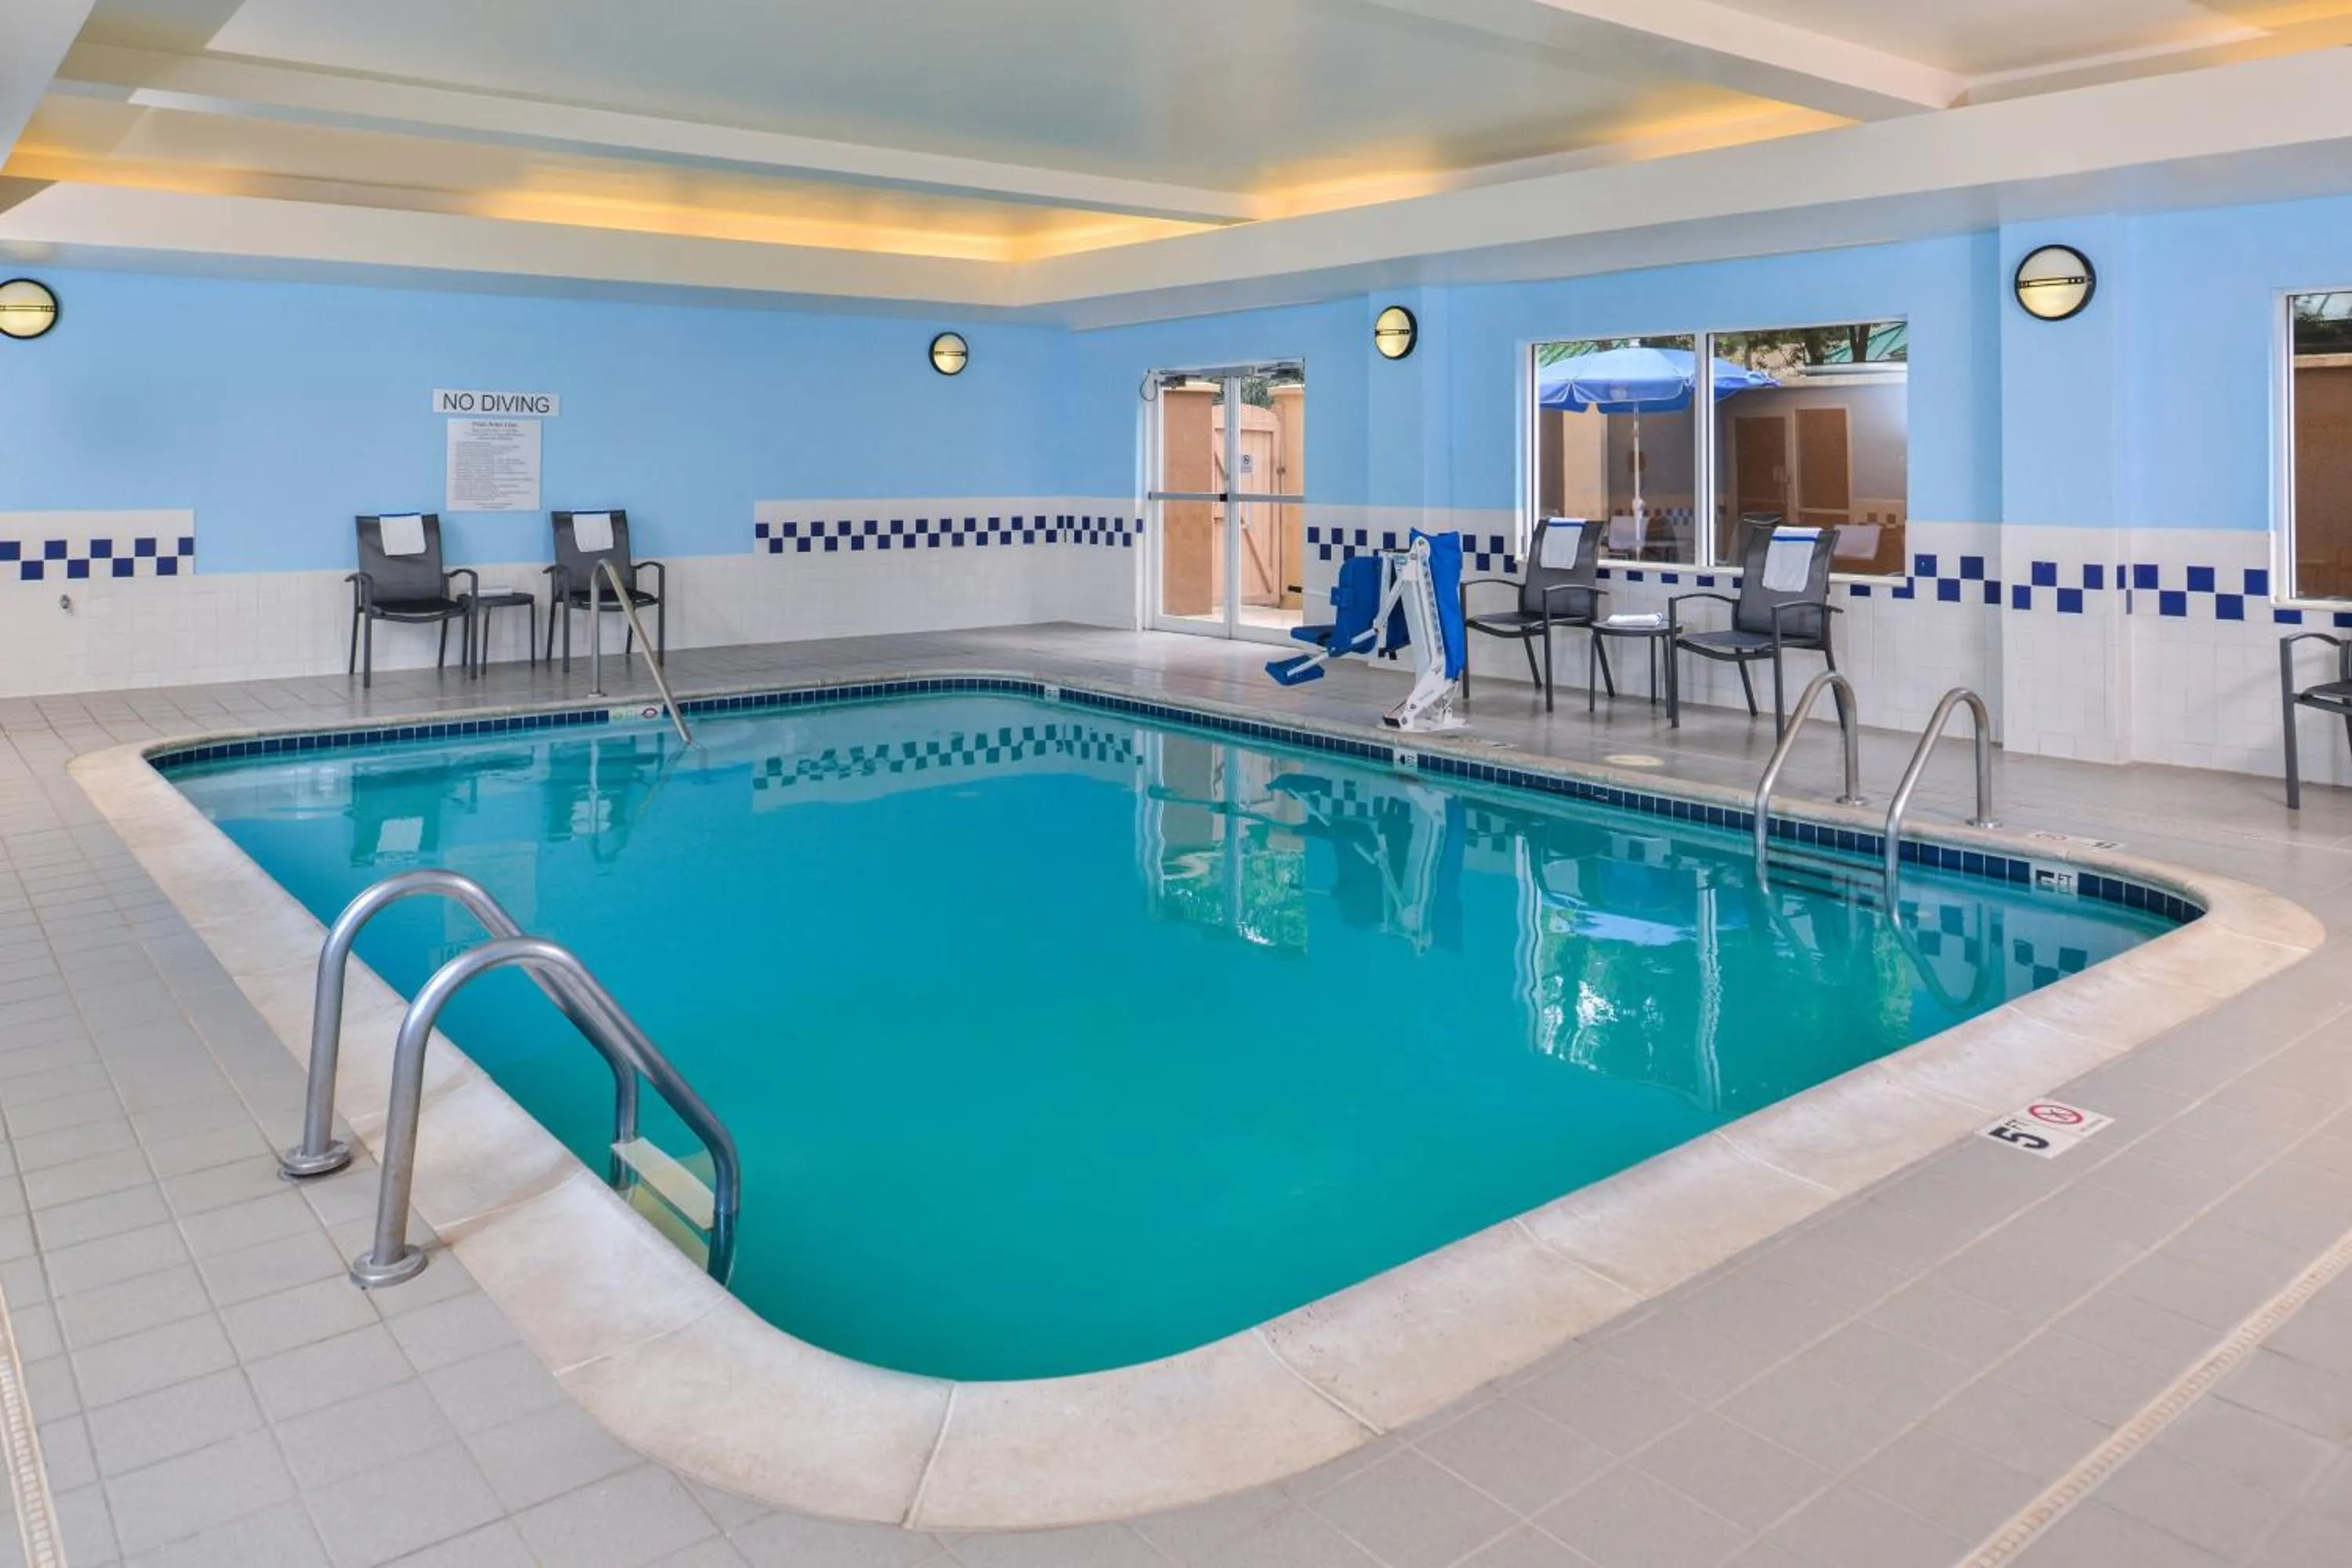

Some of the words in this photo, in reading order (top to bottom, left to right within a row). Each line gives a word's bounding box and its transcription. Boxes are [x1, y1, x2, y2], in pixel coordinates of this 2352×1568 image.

[443, 393, 474, 411] NO
[481, 394, 550, 413] DIVING
[1989, 1127, 2049, 1149] 5
